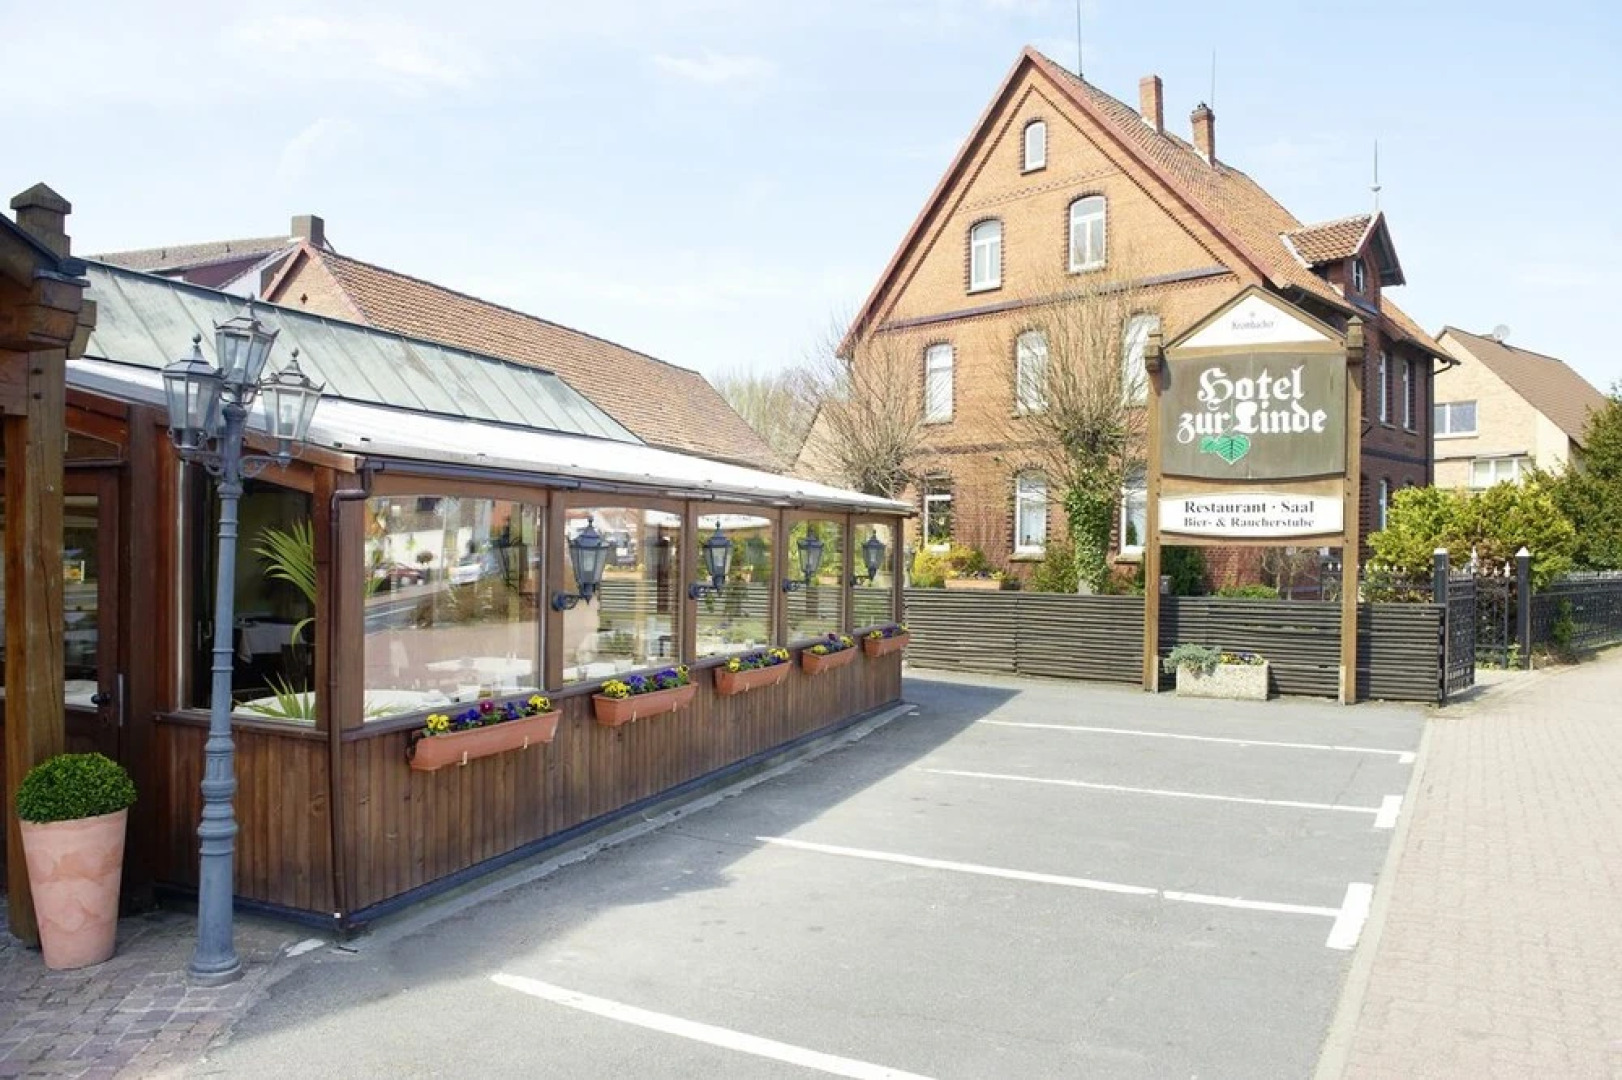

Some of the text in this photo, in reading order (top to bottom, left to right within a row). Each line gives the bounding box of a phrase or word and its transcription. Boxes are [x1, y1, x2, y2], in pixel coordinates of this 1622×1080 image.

[1198, 366, 1305, 411] Hotel
[1177, 400, 1328, 444] zur Linde
[1185, 501, 1266, 513] Restaurant
[1281, 501, 1314, 513] Saal
[1184, 517, 1315, 528] Bier- & Raucherstube
